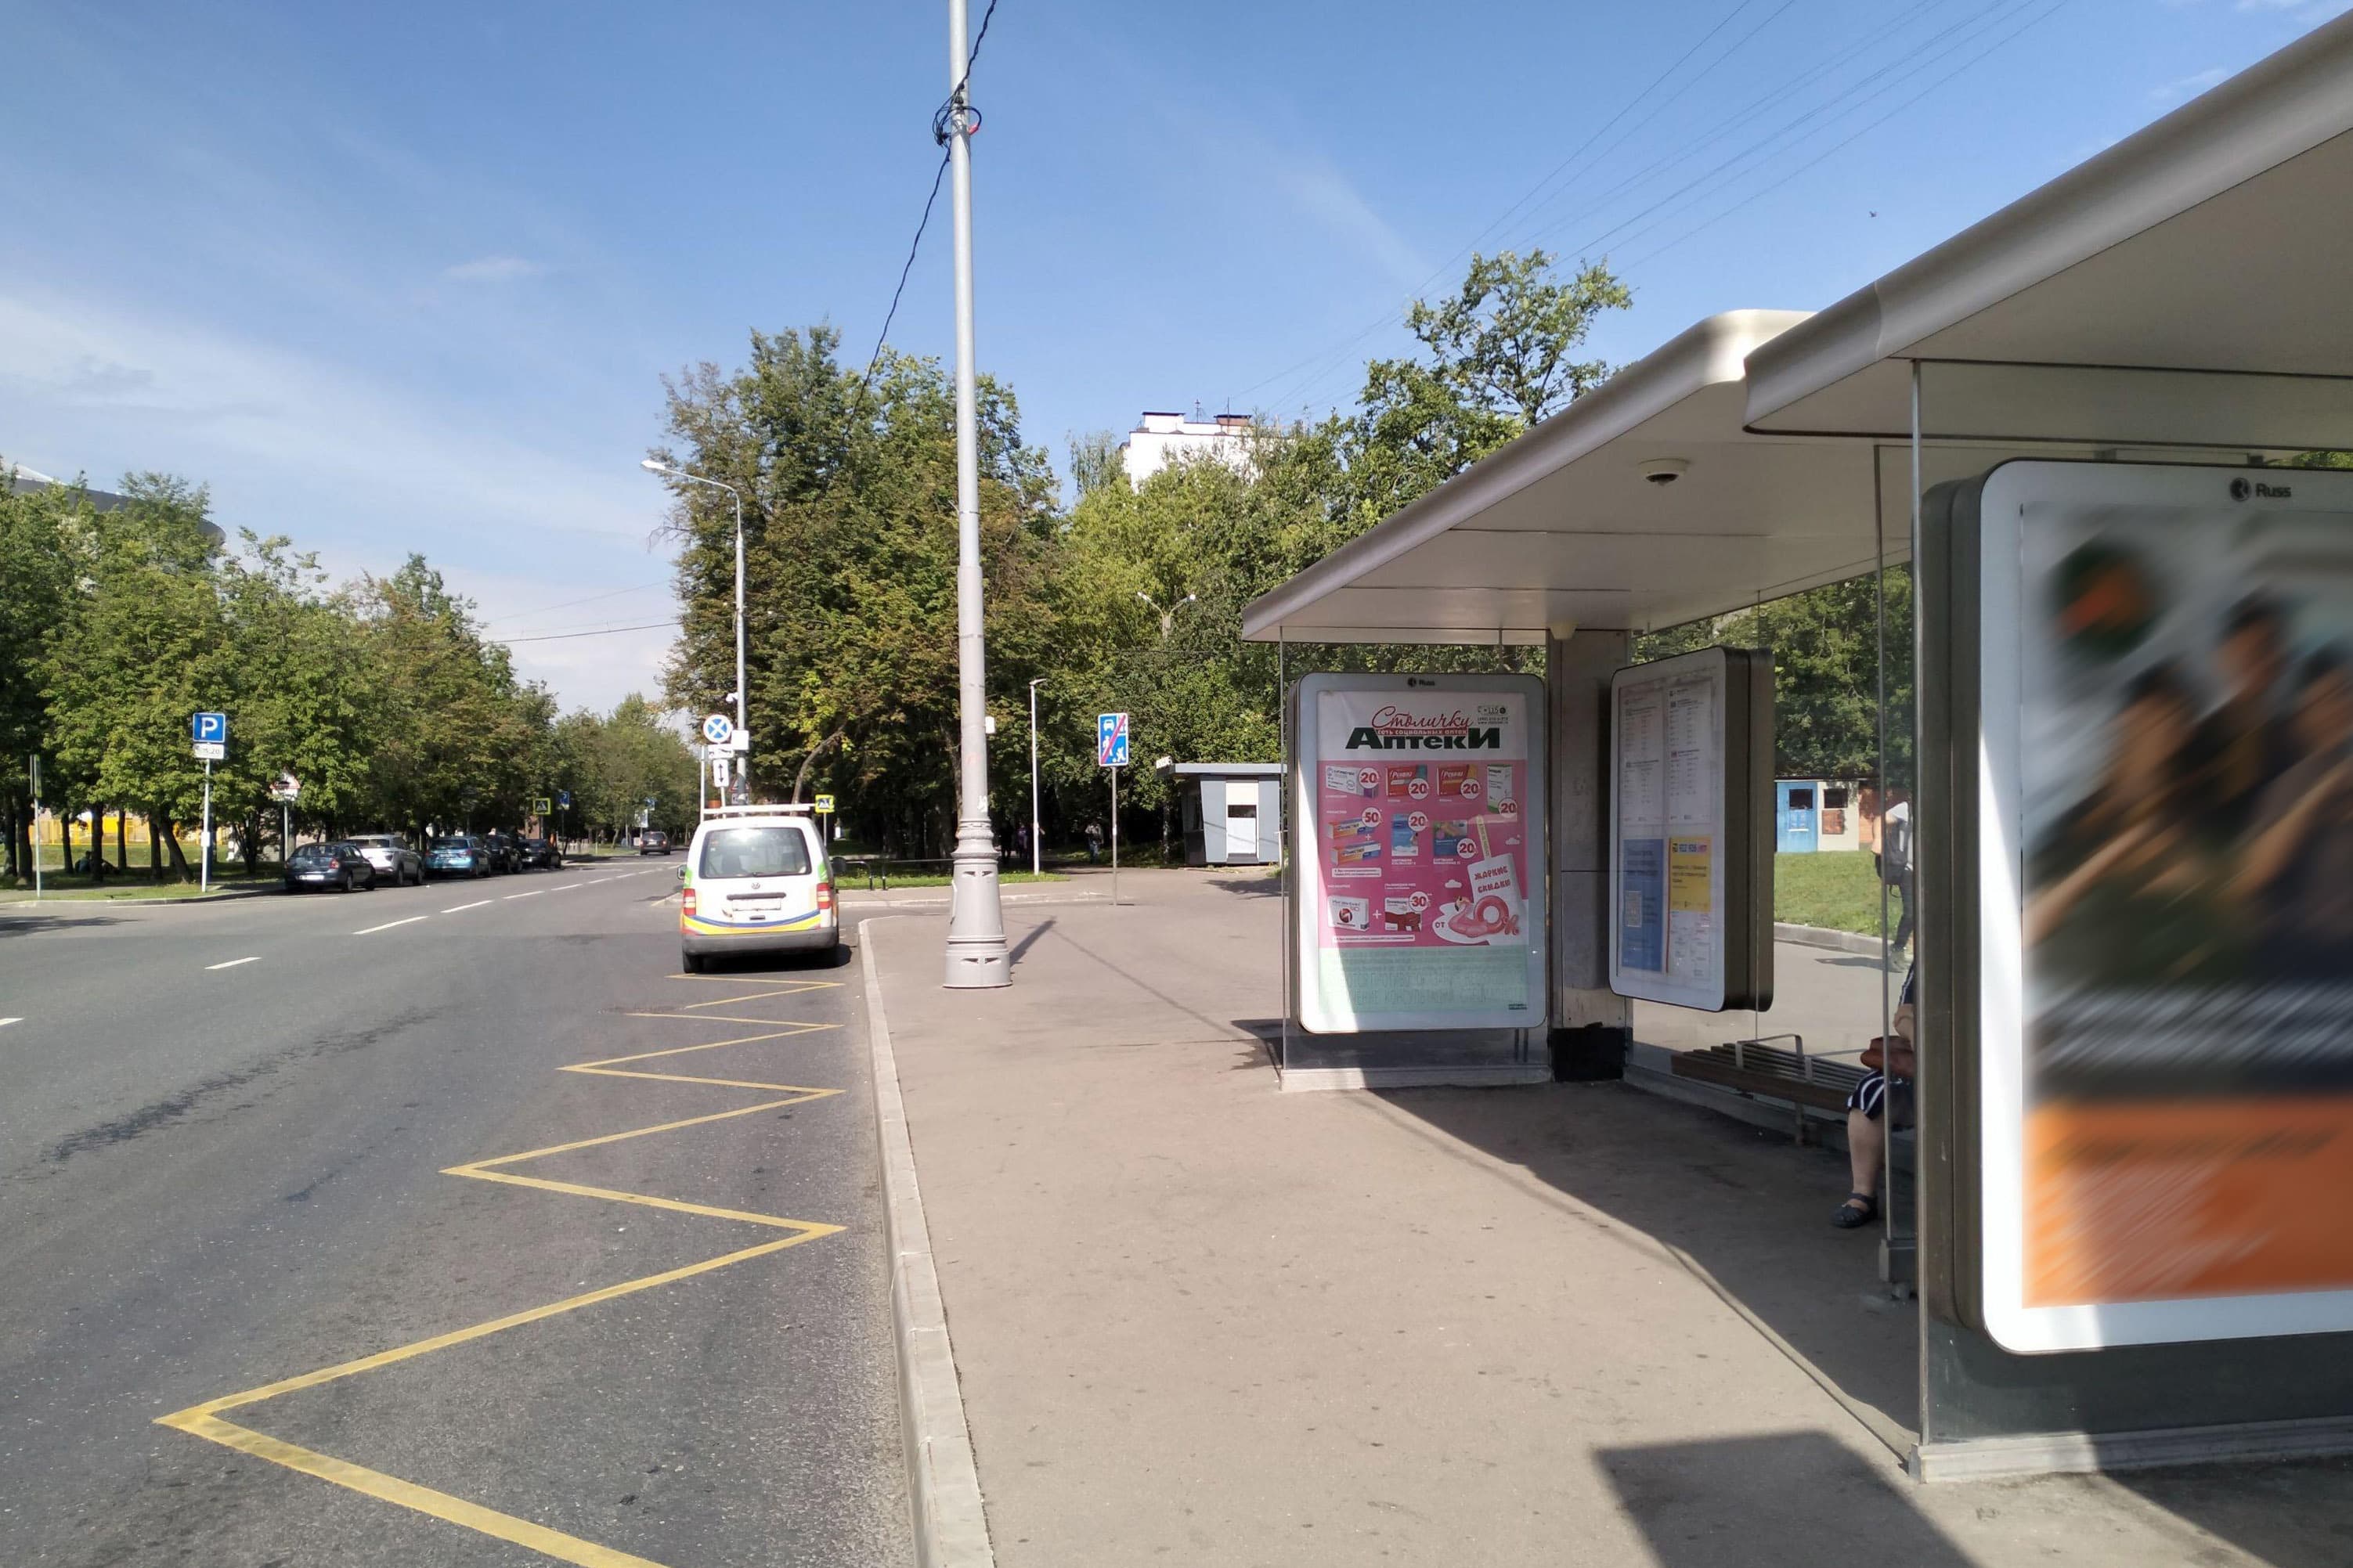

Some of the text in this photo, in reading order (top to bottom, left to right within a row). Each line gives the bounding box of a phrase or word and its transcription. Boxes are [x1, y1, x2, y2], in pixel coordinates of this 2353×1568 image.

[2256, 483, 2292, 498] Russ
[1372, 705, 1474, 729] Столички
[201, 717, 218, 737] P
[1474, 866, 1508, 880] ЖАРКИЕ
[1478, 879, 1511, 893] СКИДКИ
